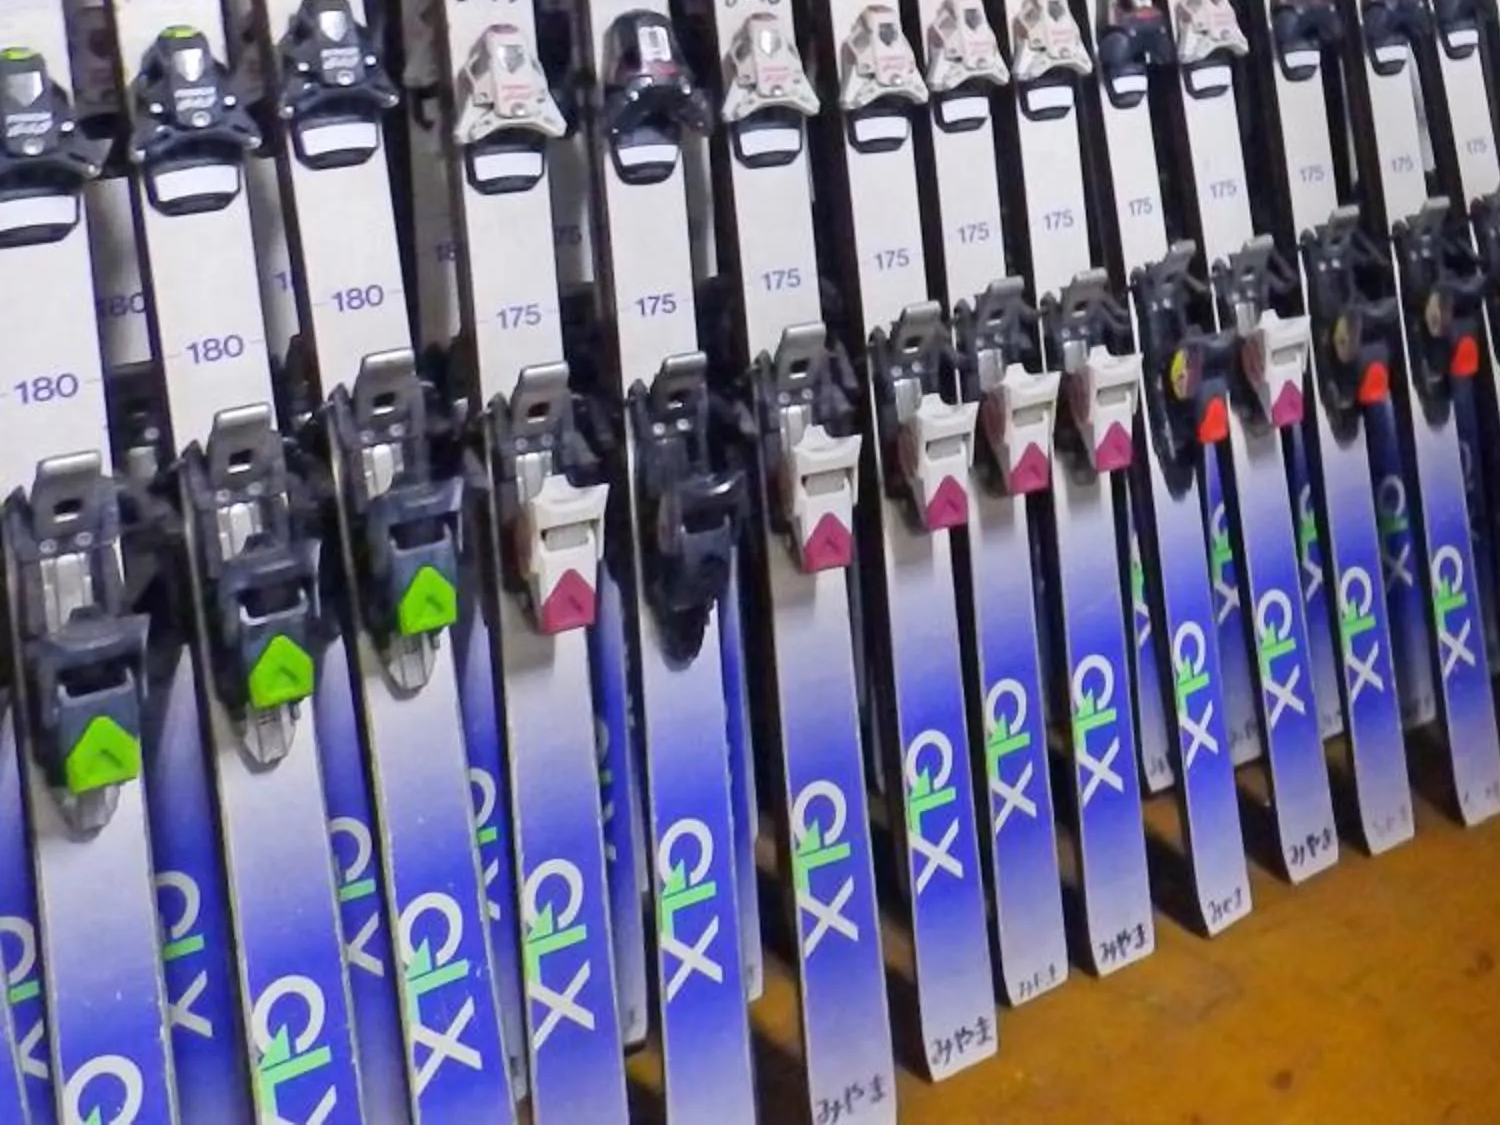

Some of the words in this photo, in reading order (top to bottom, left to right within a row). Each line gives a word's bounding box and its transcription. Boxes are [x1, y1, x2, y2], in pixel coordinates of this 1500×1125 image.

[1209, 179, 1237, 200] 175
[1299, 166, 1325, 183] 175
[1043, 209, 1074, 230] 175
[1128, 197, 1153, 216] 175
[956, 222, 990, 243] 175
[874, 248, 910, 270] 175
[761, 267, 801, 291] 175
[331, 284, 384, 313] 180
[634, 293, 678, 318] 175
[496, 303, 542, 330] 175
[186, 334, 244, 365] 180
[14, 373, 79, 404] 180
[1432, 545, 1476, 676] GLX
[1339, 566, 1384, 704] GLX
[1256, 589, 1305, 728] GLX
[1172, 621, 1219, 769] GLX
[1071, 654, 1124, 808] GLX
[985, 678, 1037, 834] GLX
[904, 729, 964, 895] GLX
[792, 780, 858, 958] GLX
[656, 818, 723, 1003] GLX
[522, 858, 595, 1051] GLX
[1099, 922, 1149, 962] みやま
[931, 1016, 993, 1065] みやま
